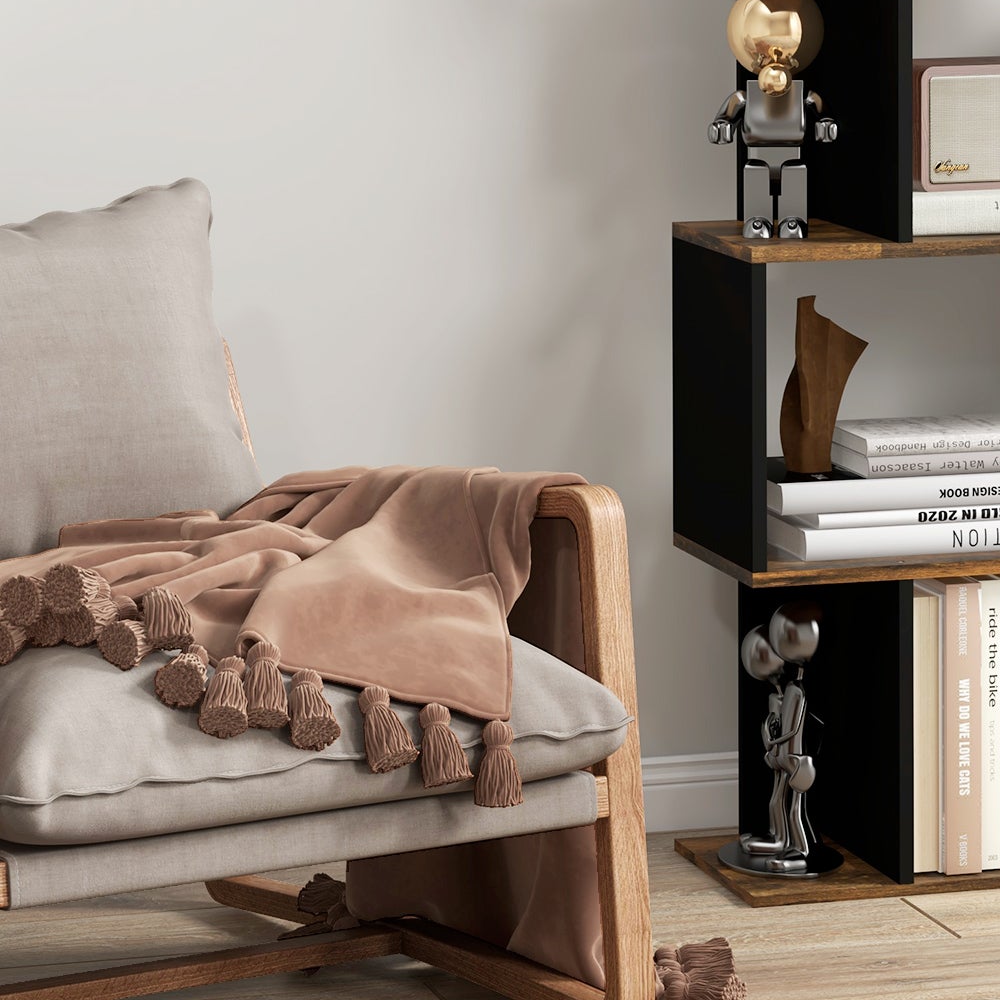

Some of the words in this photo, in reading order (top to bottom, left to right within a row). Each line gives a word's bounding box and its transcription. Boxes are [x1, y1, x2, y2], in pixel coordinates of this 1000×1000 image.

[875, 443, 926, 452] Handbook
[933, 440, 970, 450] Design
[872, 462, 931, 472] Isaacson
[940, 460, 985, 470] Walter
[939, 488, 969, 498] BOOK
[918, 510, 957, 522] 2020
[962, 509, 976, 520] IN
[989, 608, 997, 638] ride
[989, 644, 997, 669] the
[959, 678, 970, 703] WHY
[989, 674, 997, 708] bike
[959, 706, 970, 719] DO
[959, 722, 970, 738] WE
[959, 741, 970, 767] LOVE
[959, 770, 970, 796] CATS
